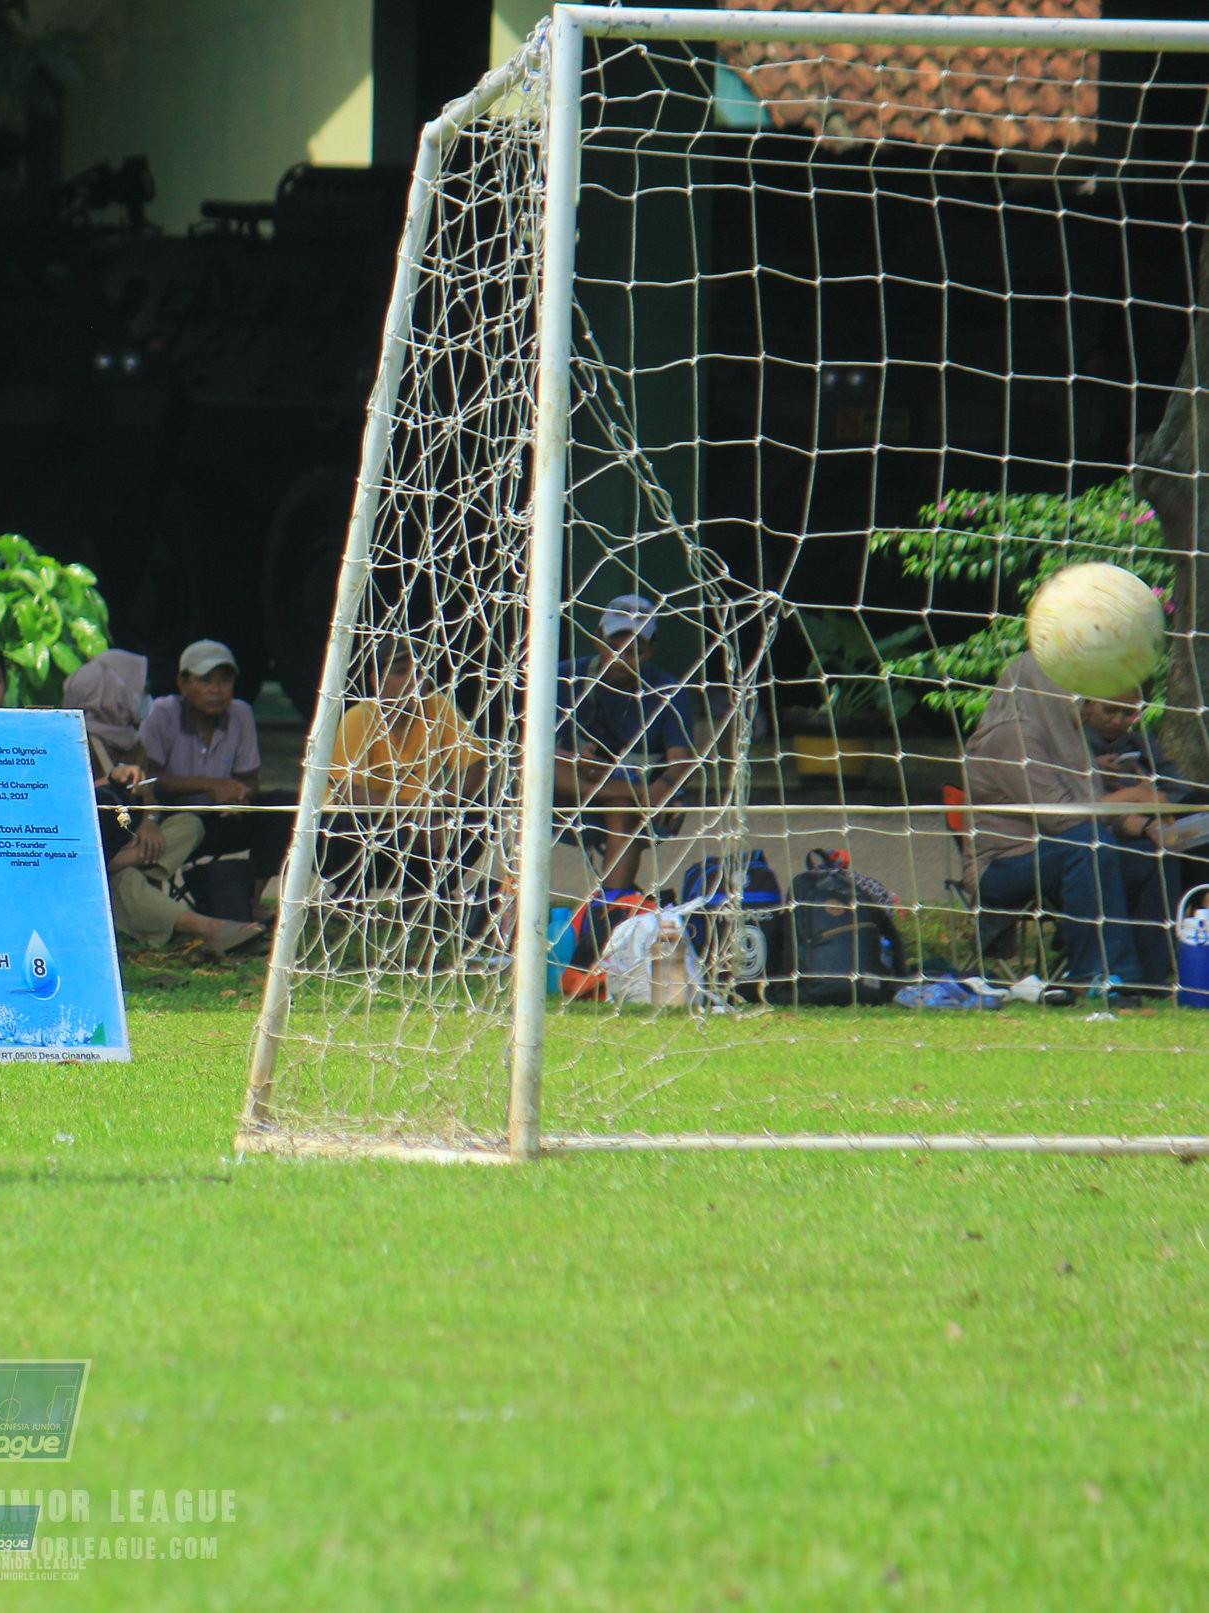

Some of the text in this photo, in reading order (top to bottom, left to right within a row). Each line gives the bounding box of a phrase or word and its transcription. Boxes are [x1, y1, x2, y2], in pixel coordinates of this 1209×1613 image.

[12, 747, 47, 756] Olympics
[10, 782, 49, 790] Champion
[24, 824, 59, 834] Ahmad
[11, 859, 40, 867] mineral
[33, 958, 47, 975] 8
[39, 1052, 59, 1060] Desa
[61, 1051, 101, 1060] Cinangka
